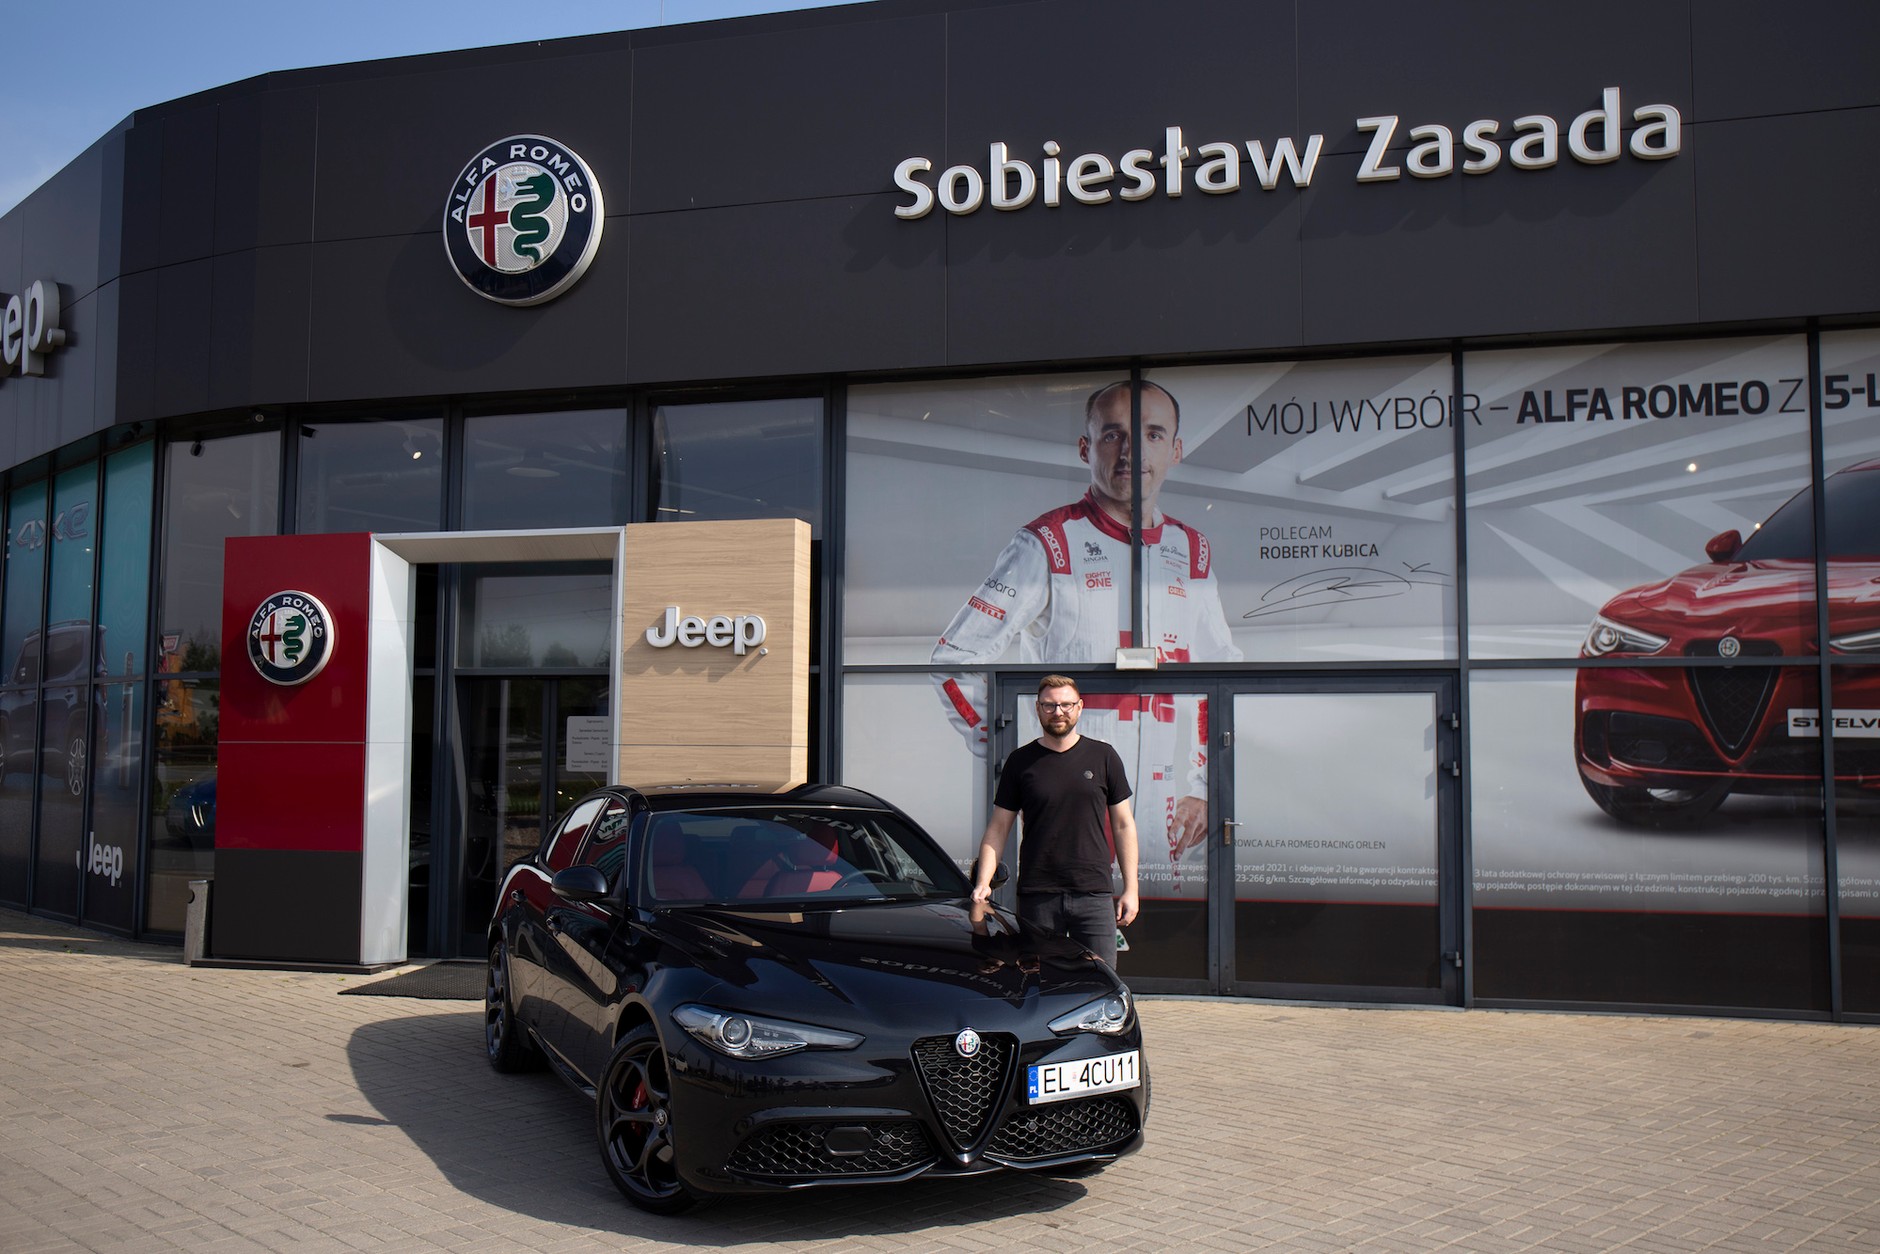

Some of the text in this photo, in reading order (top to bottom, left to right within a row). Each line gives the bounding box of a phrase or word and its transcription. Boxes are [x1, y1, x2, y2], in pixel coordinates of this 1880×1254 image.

[892, 86, 1683, 220] Sobiesław Zasada
[451, 144, 587, 223] ALFA ROMEO
[1246, 396, 1318, 436] MÓJ
[1329, 390, 1483, 433] WYBÓR
[1516, 387, 1614, 424] ALFA
[1622, 380, 1770, 420] ROMEO
[1778, 378, 1805, 413] Z
[1260, 525, 1332, 541] POLECAM
[1260, 543, 1379, 560] ROBERT KUBICA
[1086, 578, 1112, 588] ONE
[252, 596, 323, 639] ALFA ROMEO
[645, 606, 767, 656] Jeep
[1264, 839, 1286, 848] ALFA
[1287, 839, 1320, 848] ROMEO
[1321, 840, 1354, 849] RACING
[1356, 840, 1386, 849] ORLEN
[1243, 863, 1265, 873] przed
[1266, 863, 1287, 872] 2021
[1300, 864, 1334, 874] obejmuje
[1336, 864, 1341, 873] 2
[1342, 865, 1358, 873] lata
[1359, 865, 1395, 876] gwarancji
[1482, 869, 1497, 878] lata
[1499, 870, 1546, 880] dodatkowej
[1547, 870, 1580, 881] ochrony
[1581, 871, 1627, 881] serwisowej
[1670, 872, 1702, 881] limitem
[1704, 873, 1746, 884] przebiegu
[1748, 873, 1766, 883] 200
[1289, 875, 1338, 885] Szczegółowe
[1339, 876, 1380, 887] informacje
[1388, 877, 1419, 887] odzysku
[1487, 881, 1526, 891] pojazdów,
[1527, 882, 1562, 892] postępie
[1564, 882, 1611, 893] dokonanym
[1621, 884, 1633, 894] tej
[1678, 885, 1725, 895] konstrukcji
[1726, 886, 1767, 896] pojazdów
[1768, 887, 1803, 897] zgodnej
[1029, 1085, 1038, 1094] PL
[1043, 1067, 1070, 1094] EL
[1079, 1055, 1134, 1088] 4CU11
